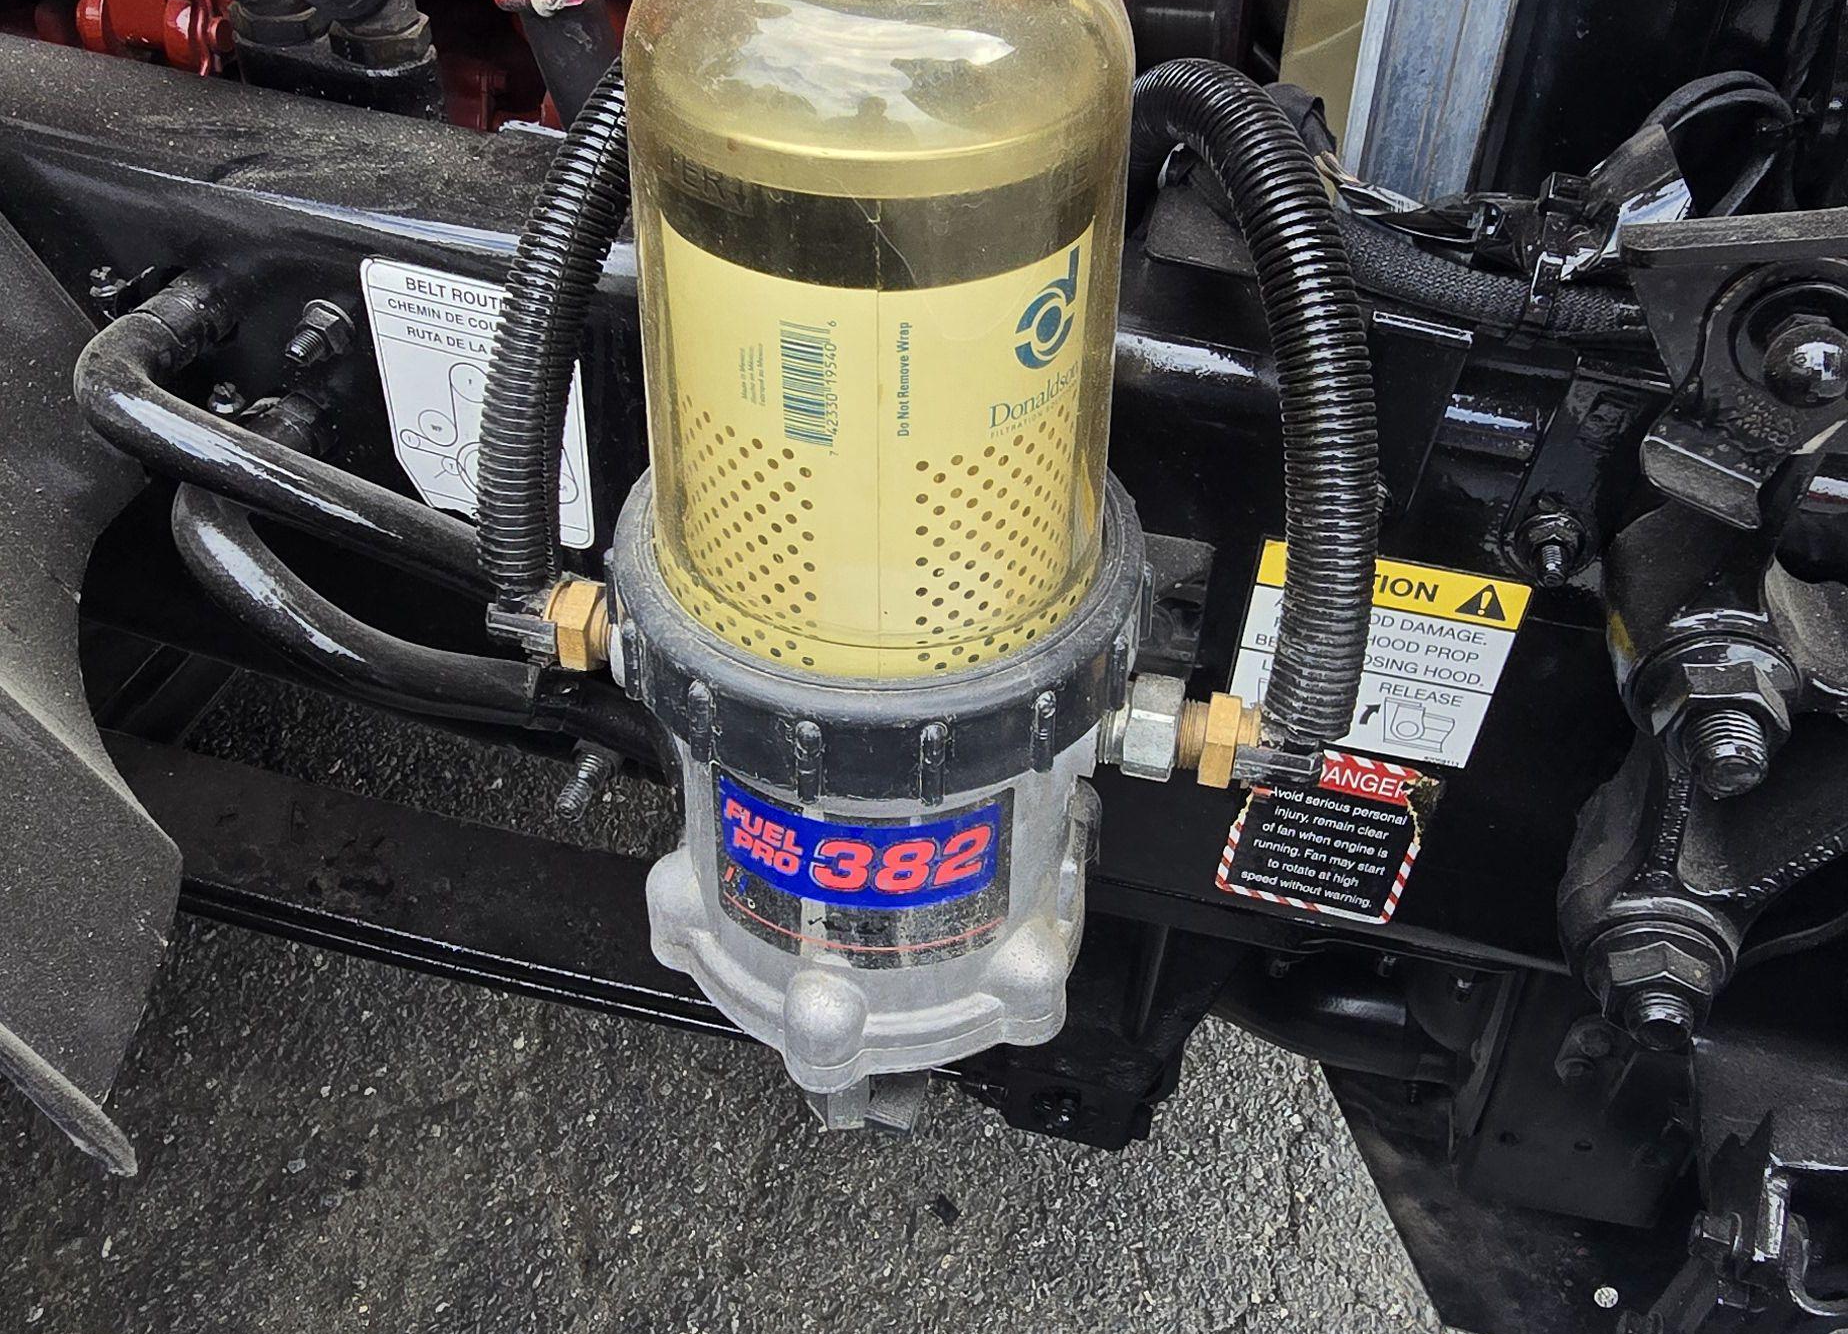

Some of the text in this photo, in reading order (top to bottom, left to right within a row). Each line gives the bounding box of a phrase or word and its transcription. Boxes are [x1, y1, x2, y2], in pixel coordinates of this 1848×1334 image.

[405, 276, 508, 310] BELT ROUTI
[387, 298, 498, 332] CHEMIN DE COU
[826, 320, 837, 328] 6
[406, 326, 488, 355] RUTA DE LA
[824, 342, 838, 385] 19540
[896, 322, 913, 437] Do Not Remove Wrap
[989, 360, 1079, 429] Donaldson
[825, 393, 839, 436] 42330
[1400, 615, 1488, 646] DAMAGE.
[1363, 654, 1419, 674] OSING
[1423, 665, 1484, 687] HOOD.
[1424, 644, 1480, 664] PROP
[1379, 681, 1464, 708] RELEASE
[724, 798, 803, 856] FUEL
[1305, 795, 1350, 813] serious
[1352, 806, 1408, 826] personal
[1262, 823, 1388, 858] of fan when engine is
[1313, 816, 1355, 833] remain
[1357, 824, 1390, 840] clear
[732, 826, 801, 875] PRO
[809, 823, 993, 894] 382
[1253, 838, 1386, 876] running. Fan may start
[1240, 871, 1373, 909] speed without warning.
[1267, 858, 1359, 888] to rotate at high
